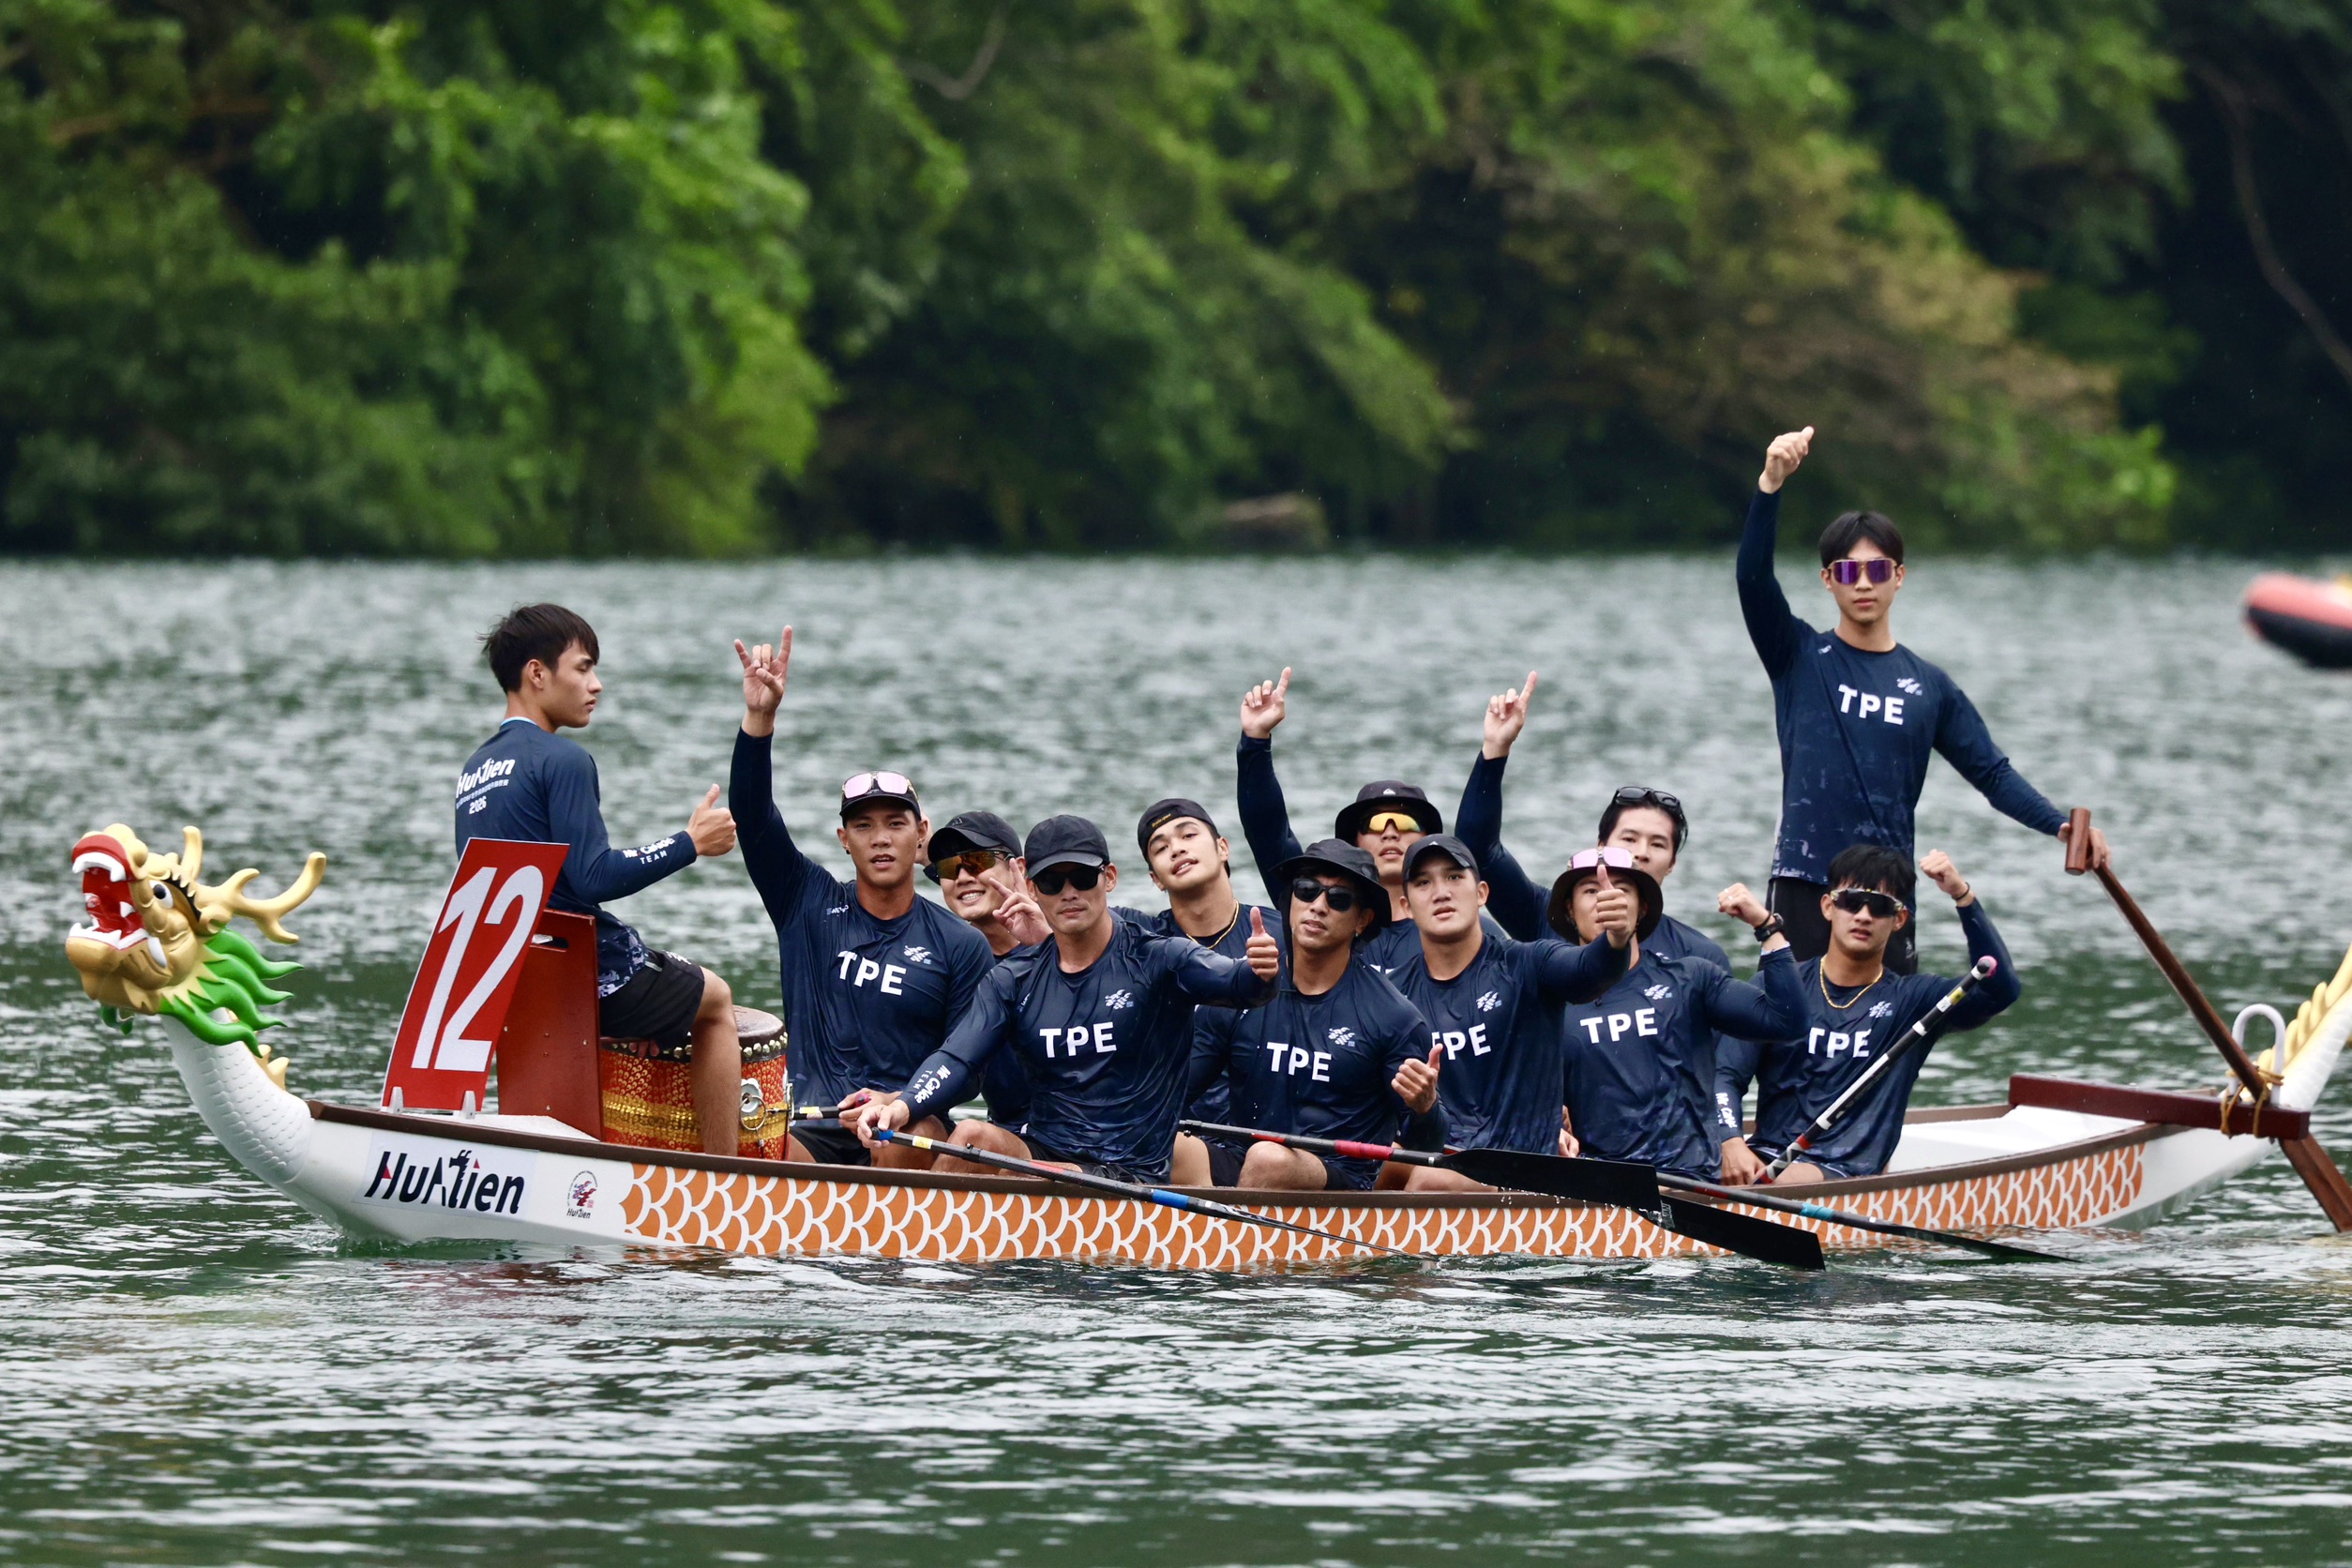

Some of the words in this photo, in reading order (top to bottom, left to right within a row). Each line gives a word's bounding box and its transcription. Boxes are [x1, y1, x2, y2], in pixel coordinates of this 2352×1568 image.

[1838, 684, 1905, 725] TPE
[469, 795, 487, 814] 2026
[640, 850, 668, 865] TEAM
[411, 865, 544, 1072] 12
[837, 950, 907, 996] TPE
[1039, 1021, 1117, 1058] TPE
[1579, 1007, 1658, 1044] TPE
[1808, 1027, 1872, 1059] TPE
[912, 1070, 933, 1090] TEAM
[1266, 1042, 1332, 1082] TPE
